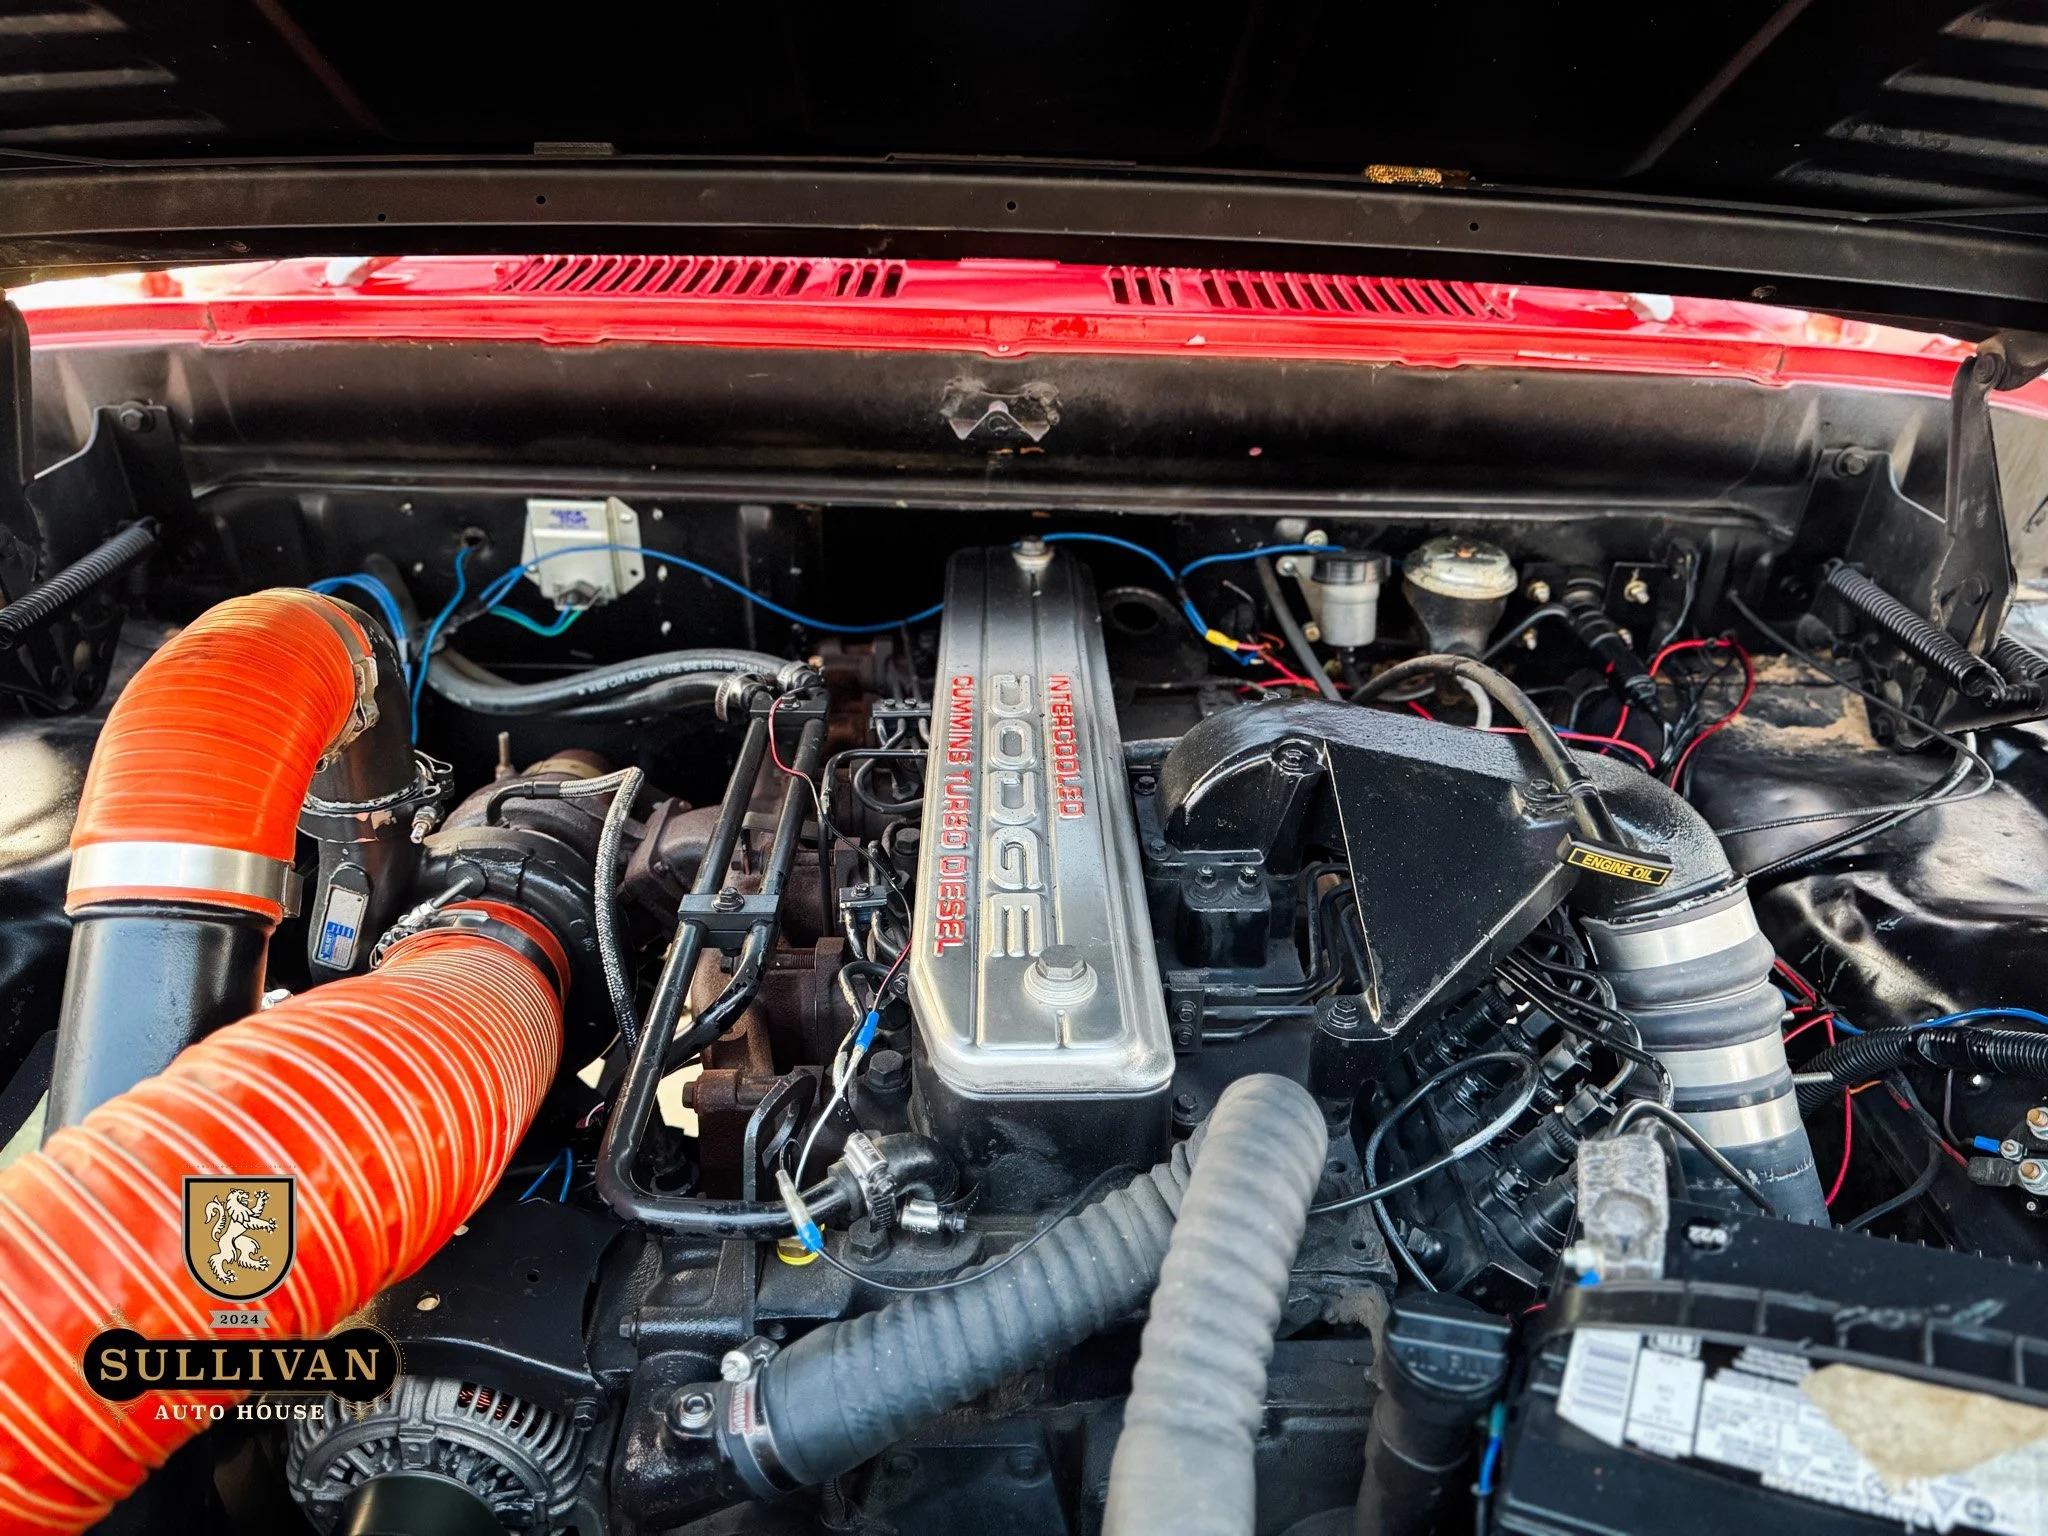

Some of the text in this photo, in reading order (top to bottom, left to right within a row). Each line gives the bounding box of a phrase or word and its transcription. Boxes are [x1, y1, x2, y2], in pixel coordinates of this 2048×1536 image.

[934, 675, 974, 957] CUMMINS TURBO DIESEL
[988, 673, 1046, 957] DODGE
[1049, 675, 1086, 819] INTERCOOLED
[1582, 854, 1652, 880] ENGINE OIL
